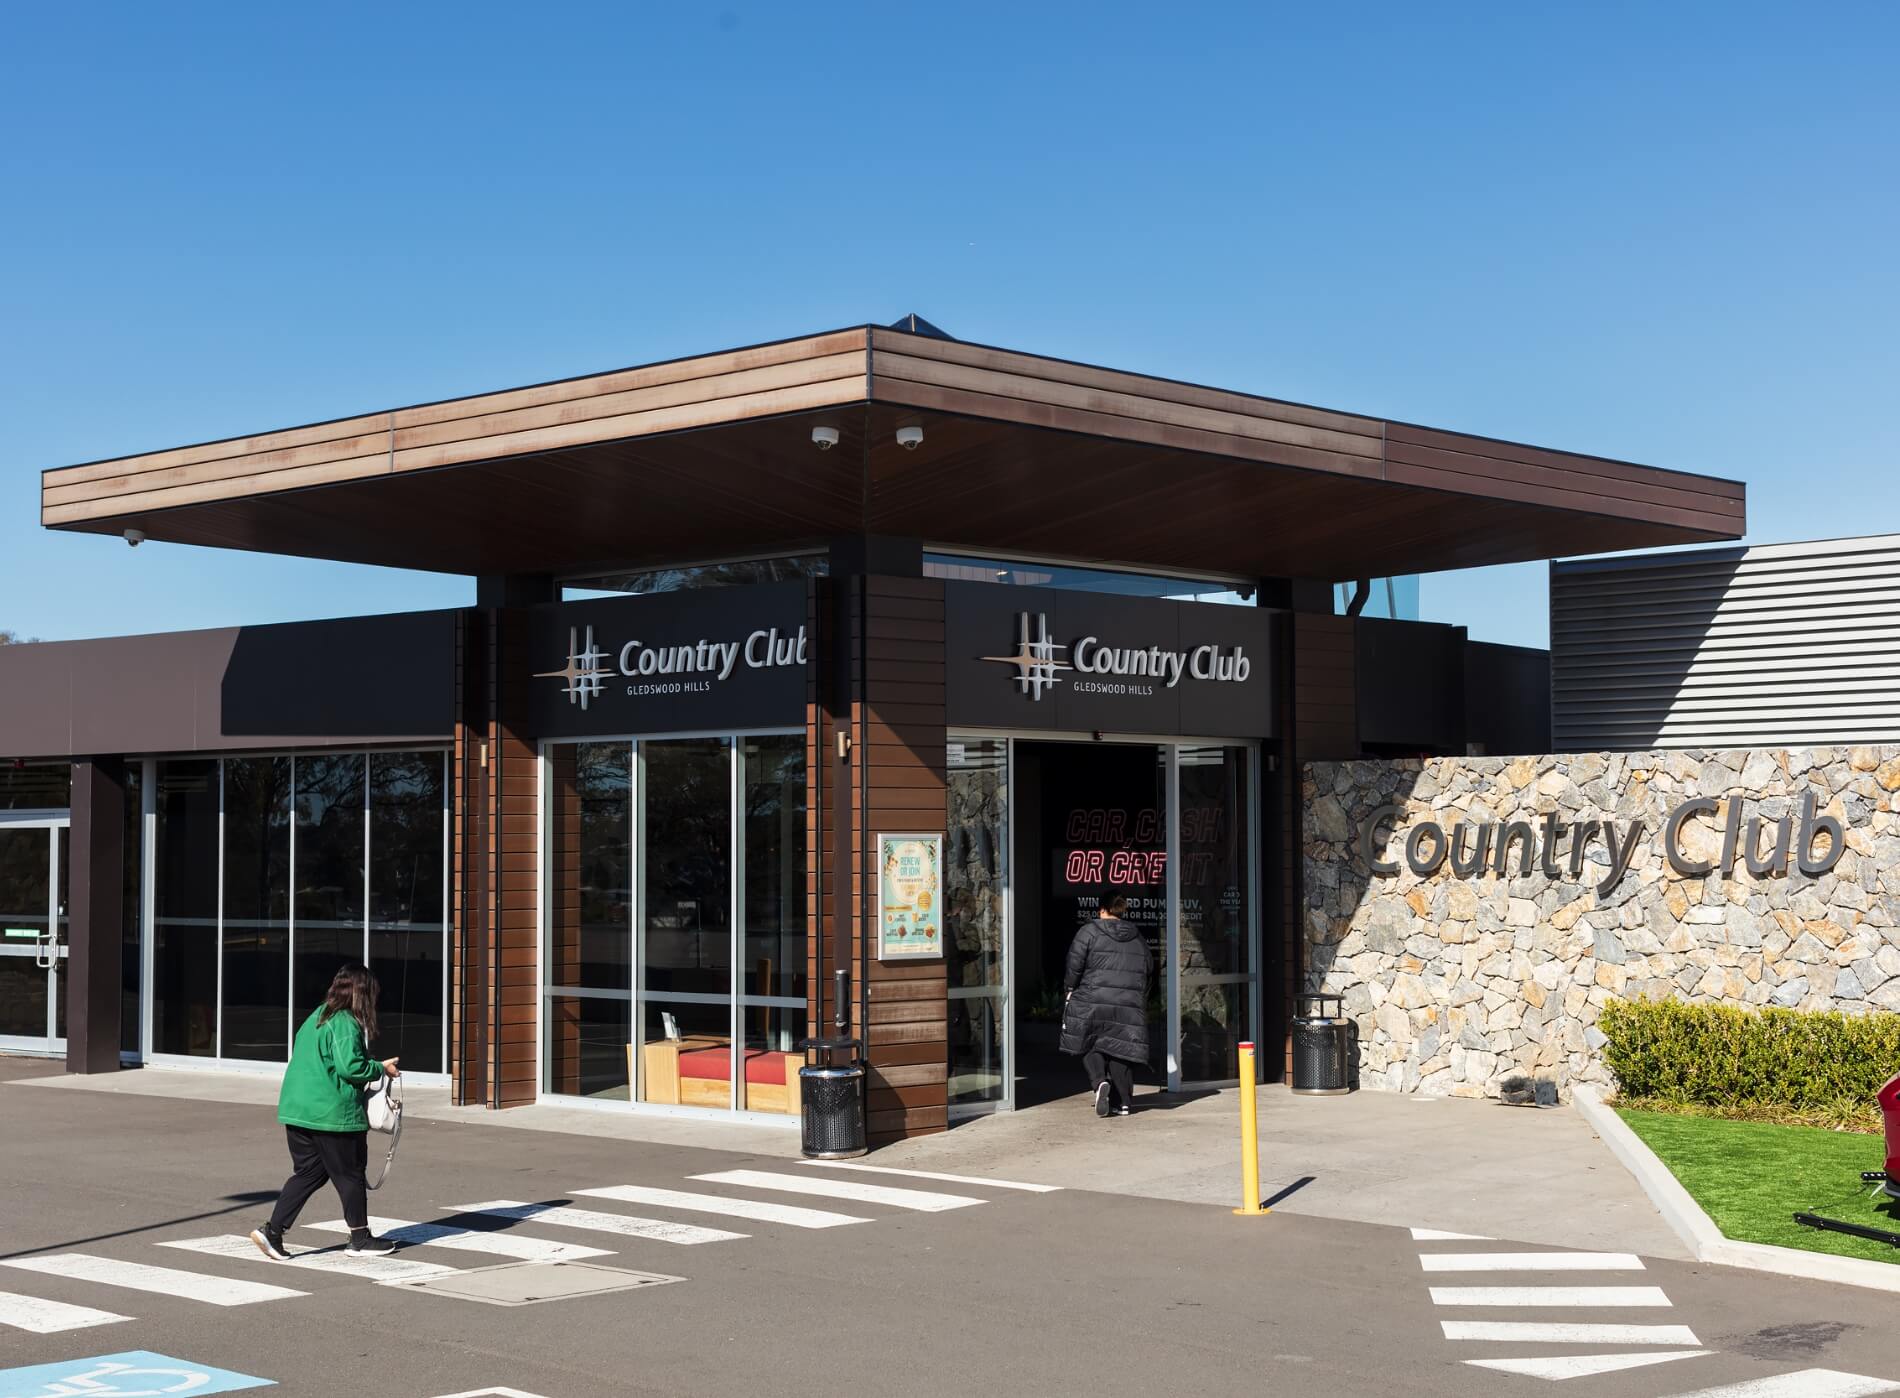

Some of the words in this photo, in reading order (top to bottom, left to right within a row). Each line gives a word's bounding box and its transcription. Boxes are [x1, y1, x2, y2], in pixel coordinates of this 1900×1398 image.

[619, 639, 740, 681] Country
[744, 625, 807, 668] Club
[1073, 636, 1187, 688] Country
[1189, 644, 1250, 682] Club
[627, 683, 681, 696] GLEDSWOOD
[684, 681, 710, 693] HILLS
[1073, 682, 1126, 694] GLEDSWOOD
[1129, 685, 1153, 695] HILLS
[1362, 801, 1644, 896] Country
[1664, 793, 1846, 876] Club
[1065, 850, 1105, 883] OR
[1109, 851, 1213, 886] CREIT
[1077, 896, 1099, 908] WIN
[1143, 898, 1167, 909] PUM
[1130, 911, 1141, 919] OR
[1180, 912, 1203, 921] REDIT
